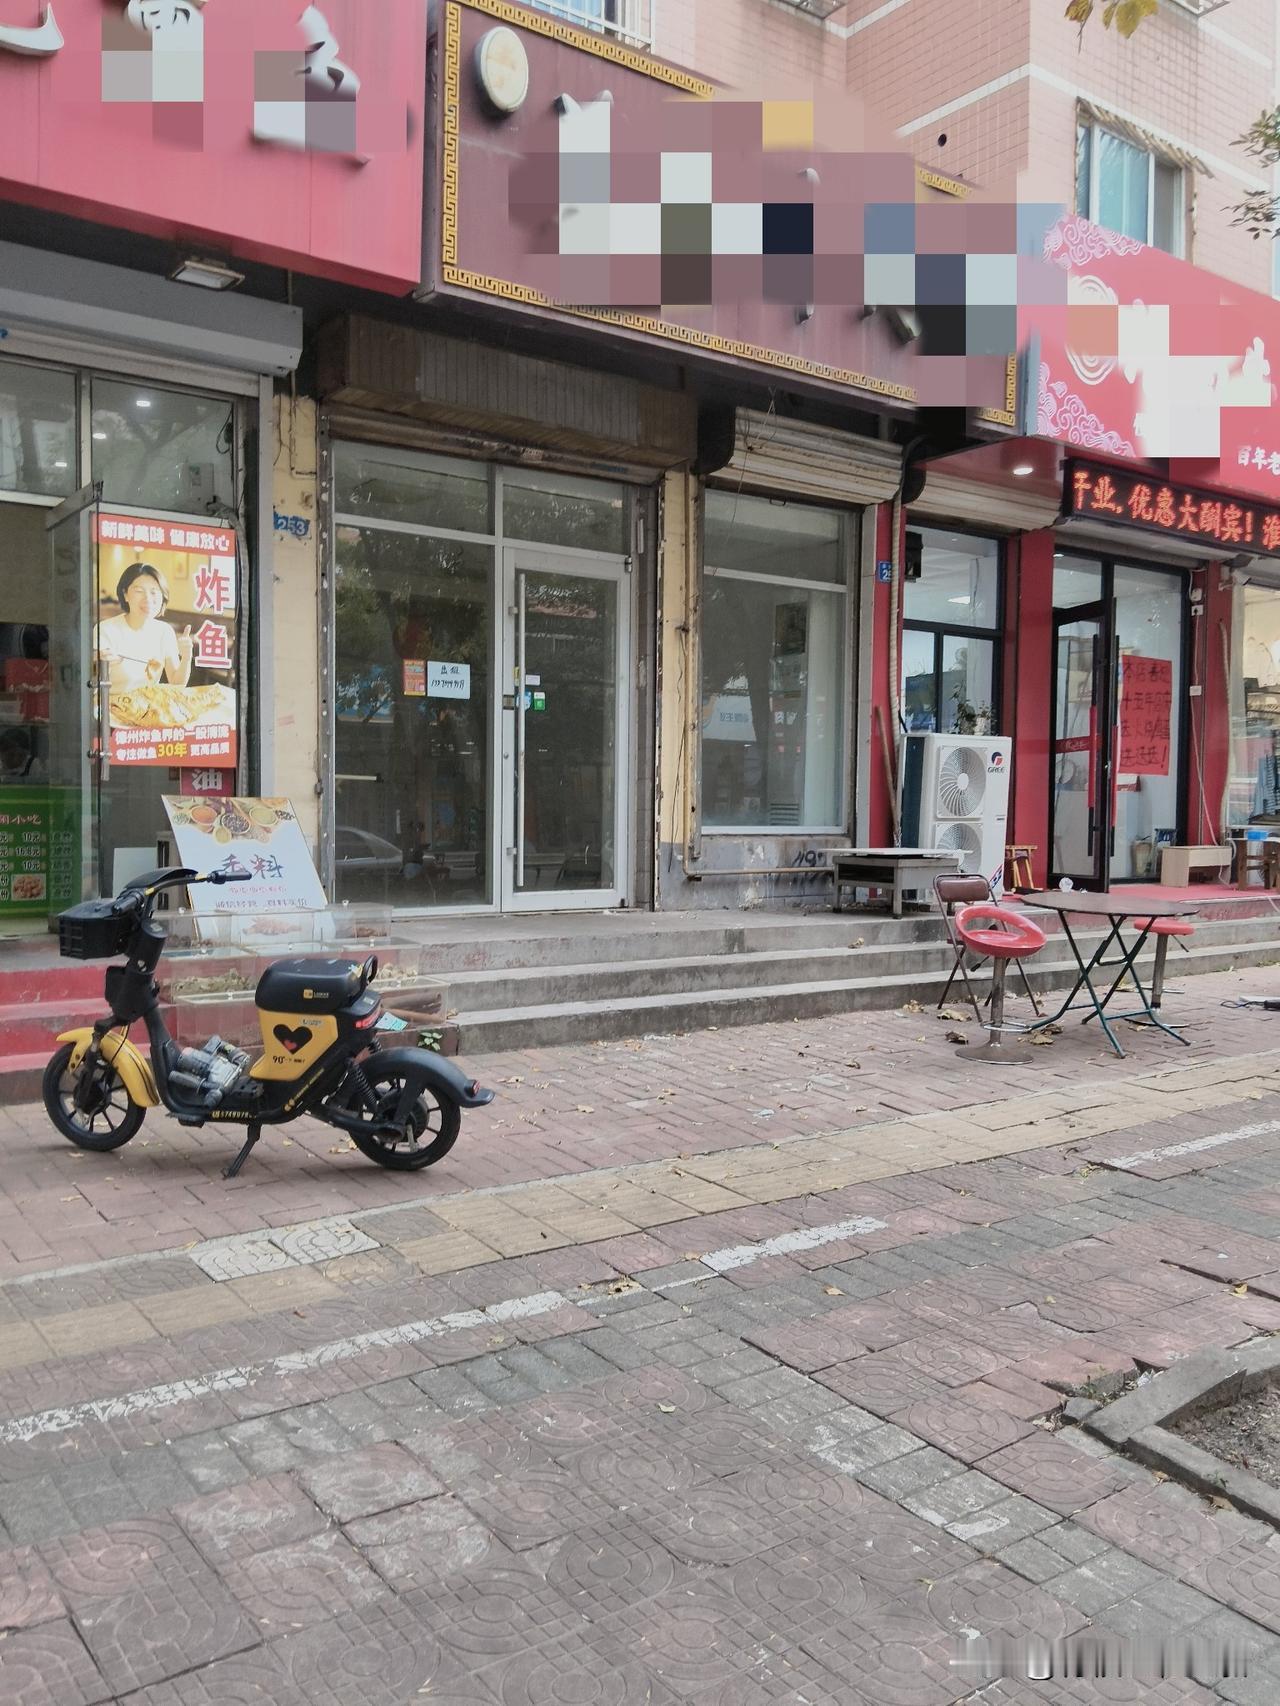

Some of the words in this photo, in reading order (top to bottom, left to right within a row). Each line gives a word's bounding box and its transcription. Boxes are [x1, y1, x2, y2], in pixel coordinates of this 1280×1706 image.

[277, 518, 306, 536] 253
[195, 566, 231, 668] 炸鱼
[191, 768, 223, 791] 油
